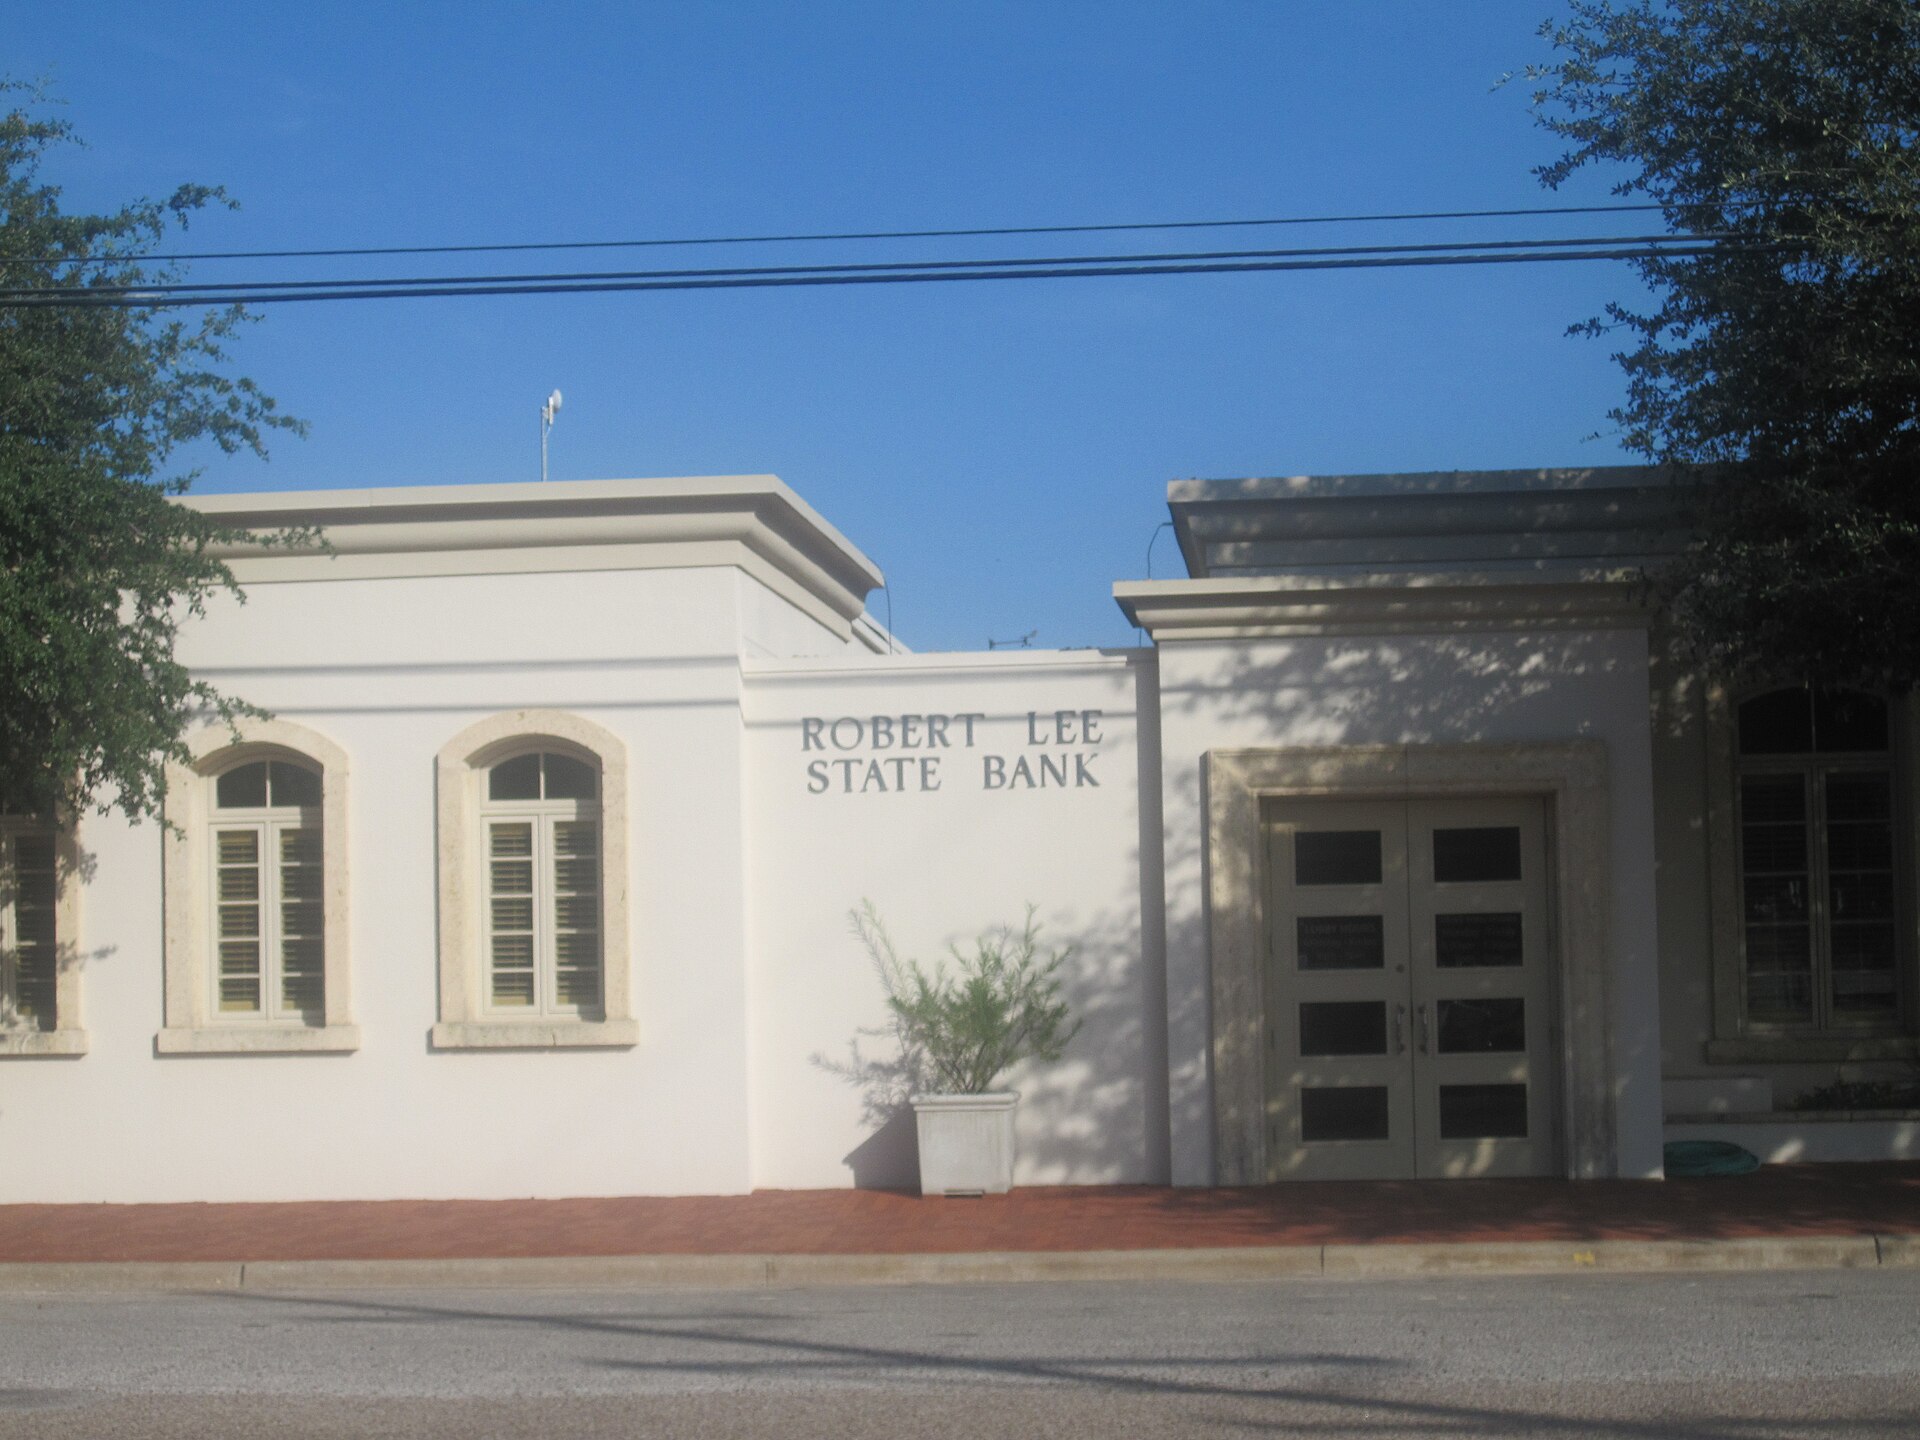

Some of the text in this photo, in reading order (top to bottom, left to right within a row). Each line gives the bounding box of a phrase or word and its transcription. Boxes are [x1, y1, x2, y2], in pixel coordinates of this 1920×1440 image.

[802, 710, 1103, 751] ROBERT LEE
[807, 753, 1101, 794] STATE BANK
